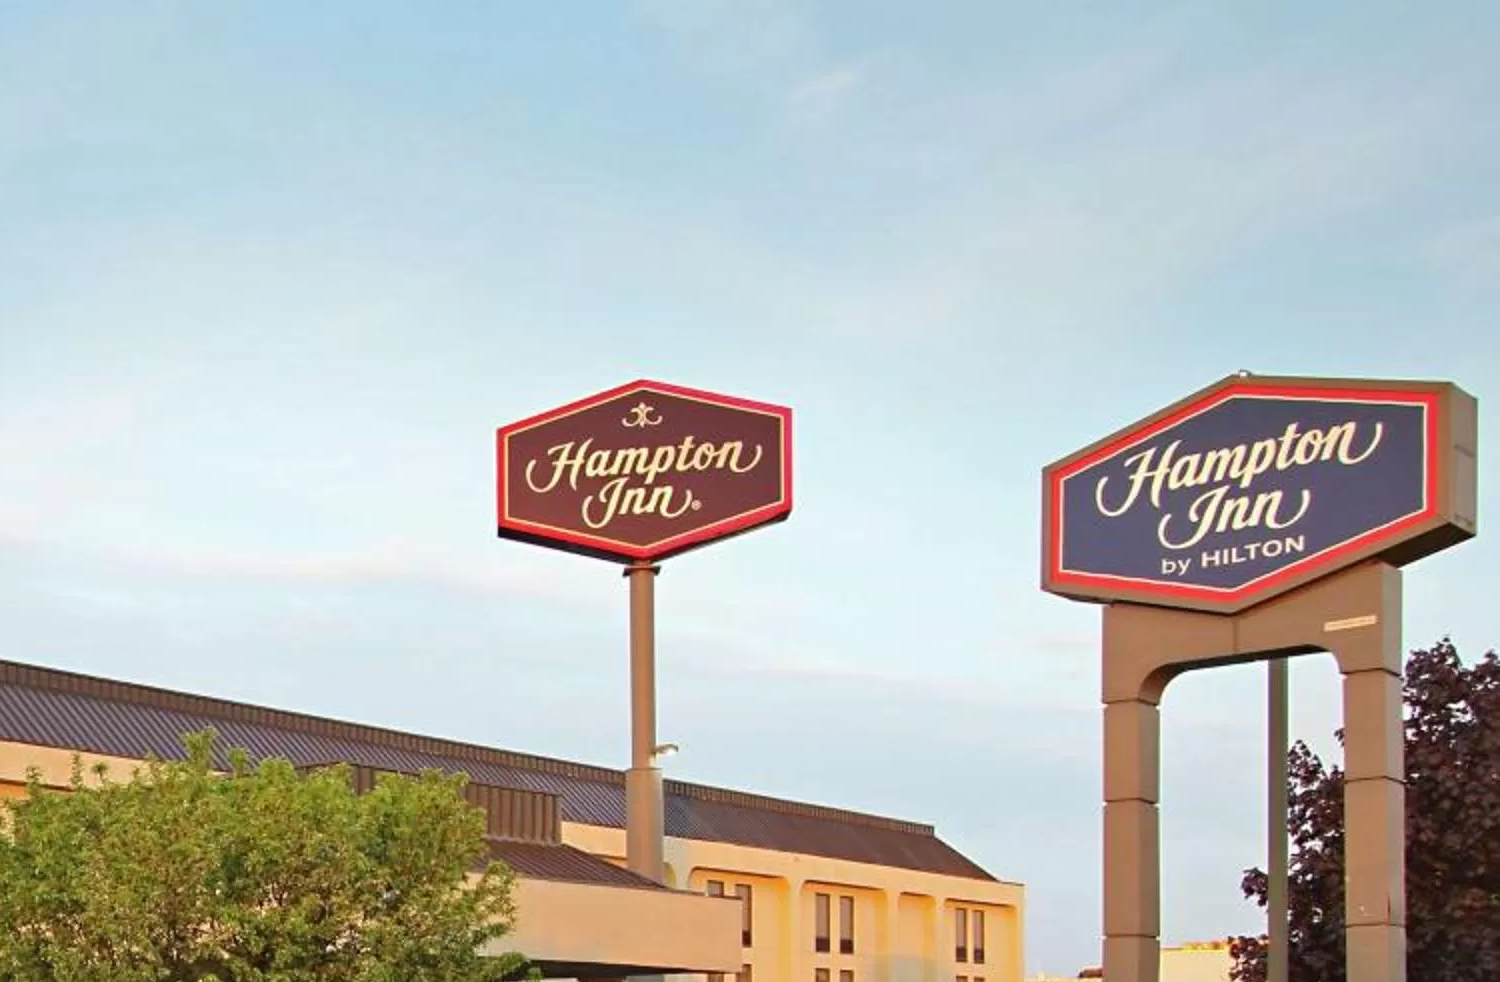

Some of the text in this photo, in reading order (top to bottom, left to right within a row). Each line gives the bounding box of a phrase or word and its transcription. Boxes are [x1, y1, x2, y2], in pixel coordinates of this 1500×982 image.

[525, 435, 763, 493] Hampton
[1096, 421, 1383, 517] Hampton
[1157, 485, 1311, 550] Inn
[1160, 535, 1306, 576] by HILTON
